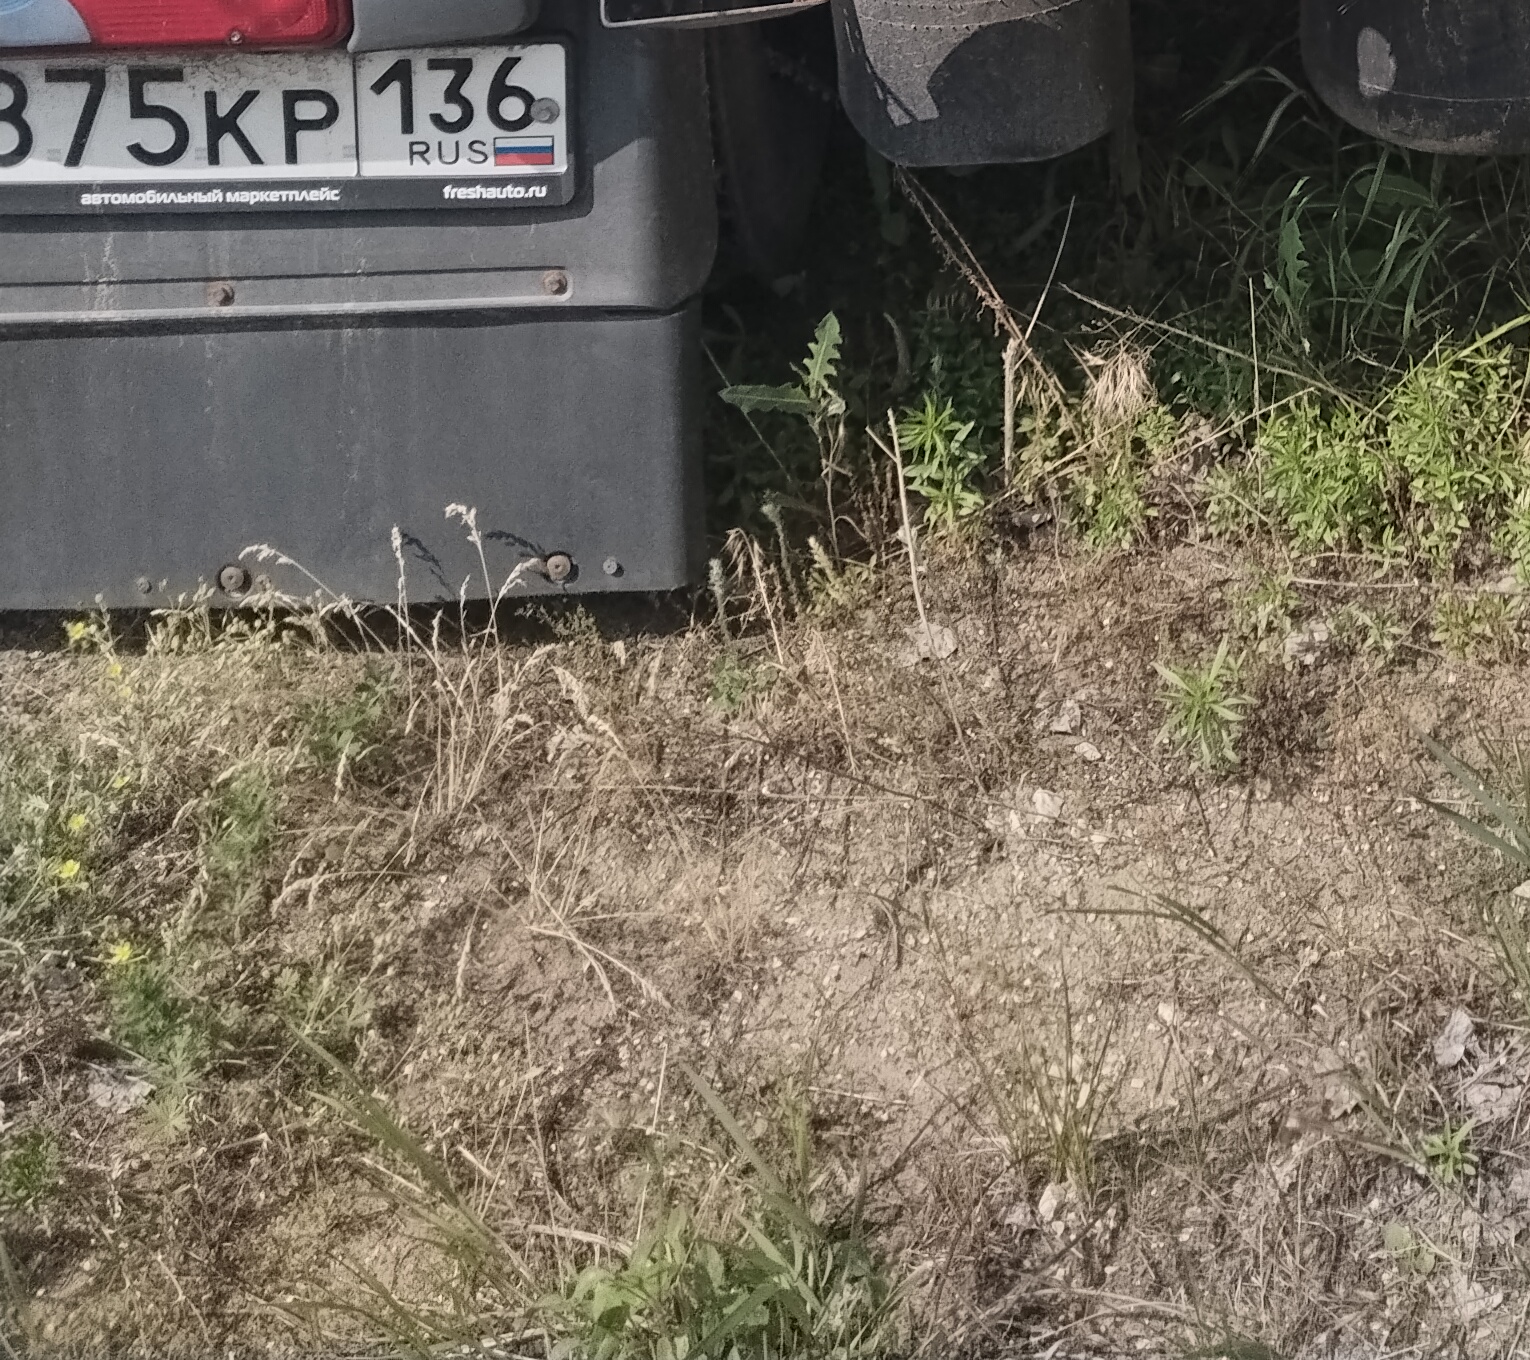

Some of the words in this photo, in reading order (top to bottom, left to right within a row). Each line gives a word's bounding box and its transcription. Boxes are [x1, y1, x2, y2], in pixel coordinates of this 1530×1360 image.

[370, 56, 537, 135] 136
[408, 140, 489, 167] RUS
[81, 188, 222, 205] автомобильный
[226, 187, 340, 206] маркетплейс
[443, 183, 548, 200] freshauto.ru
